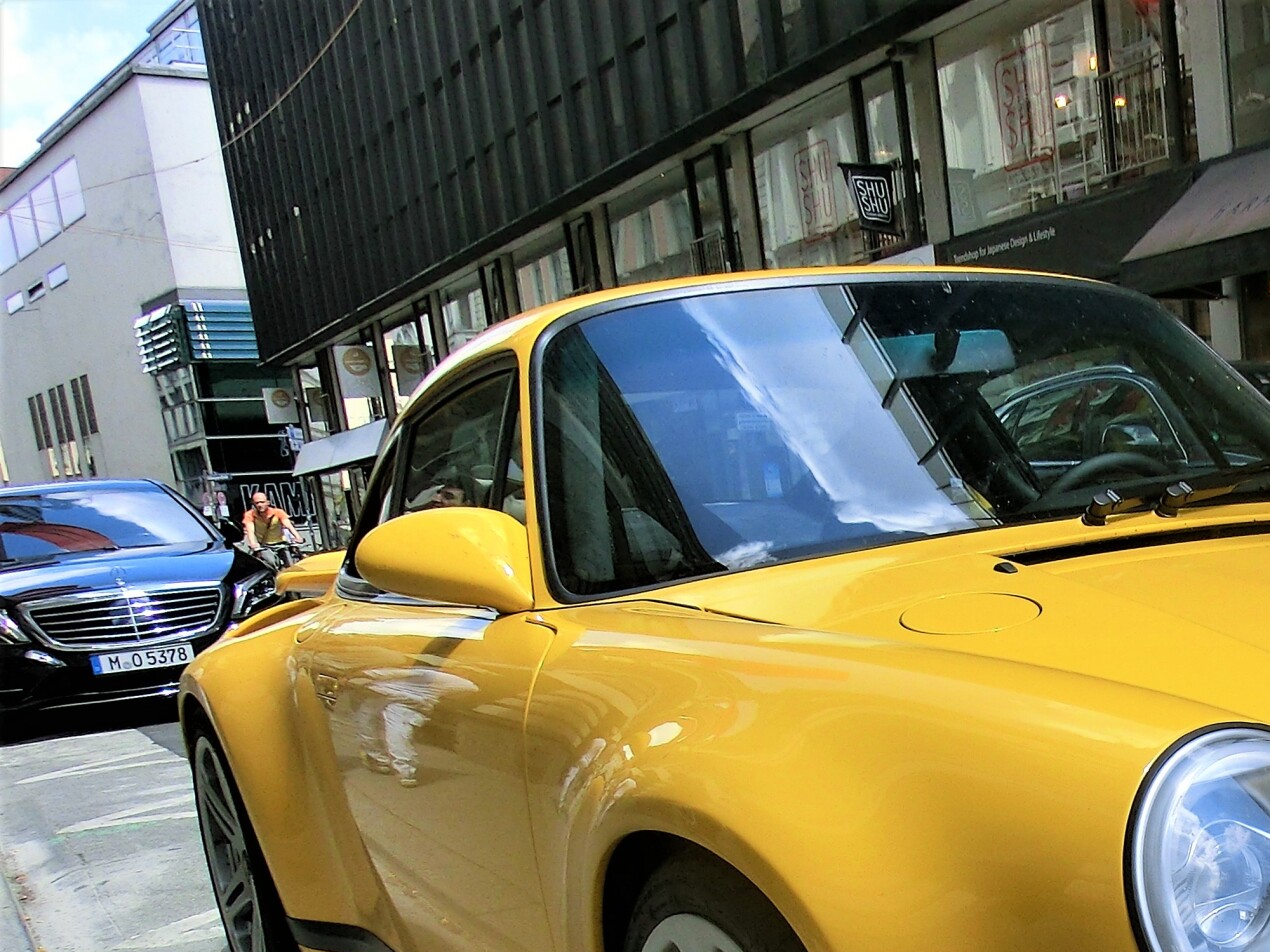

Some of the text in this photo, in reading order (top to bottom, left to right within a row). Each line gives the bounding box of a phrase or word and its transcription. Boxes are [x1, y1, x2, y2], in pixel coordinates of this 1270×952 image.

[856, 180, 885, 198] SHU
[861, 196, 888, 214] SHU
[979, 246, 987, 257] for
[987, 241, 1010, 255] Japanese
[1010, 235, 1029, 249] Design
[1033, 226, 1056, 241] Lifestyle
[108, 656, 122, 670] M
[146, 647, 188, 666] 5378
